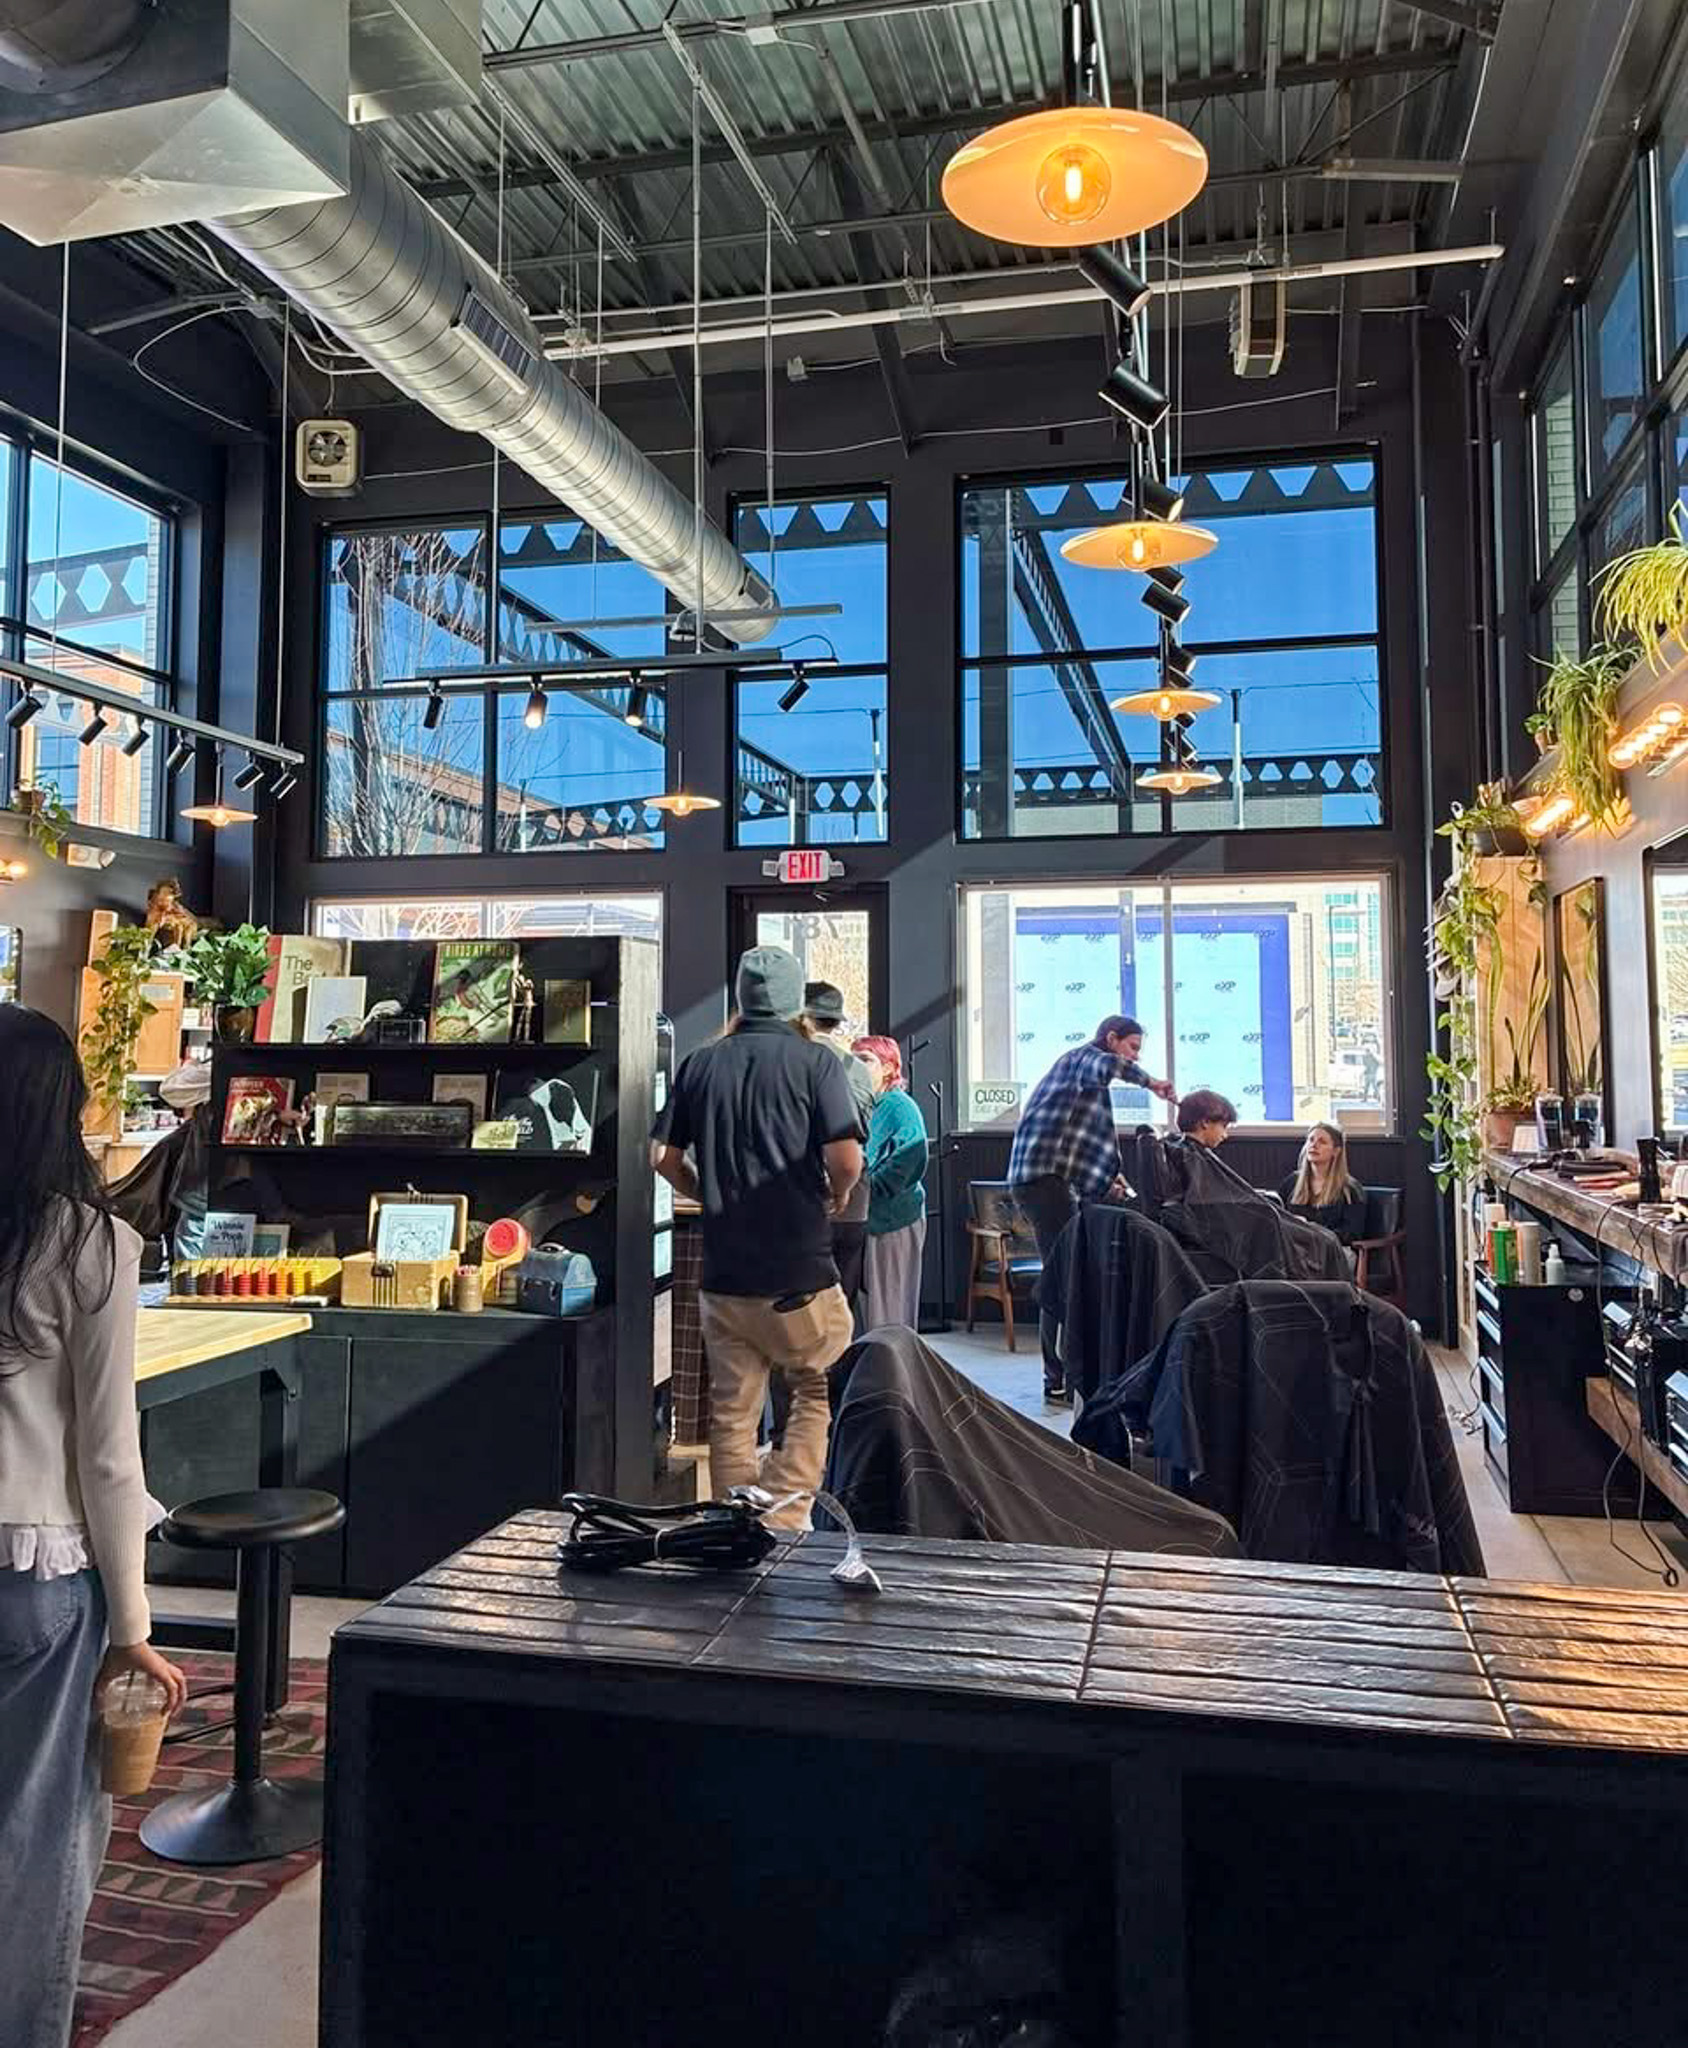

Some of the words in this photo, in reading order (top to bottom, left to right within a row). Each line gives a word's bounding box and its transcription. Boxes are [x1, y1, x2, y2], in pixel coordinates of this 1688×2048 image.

[788, 853, 823, 879] EXIT
[284, 956, 313, 970] The
[975, 1089, 1015, 1105] CLOSED
